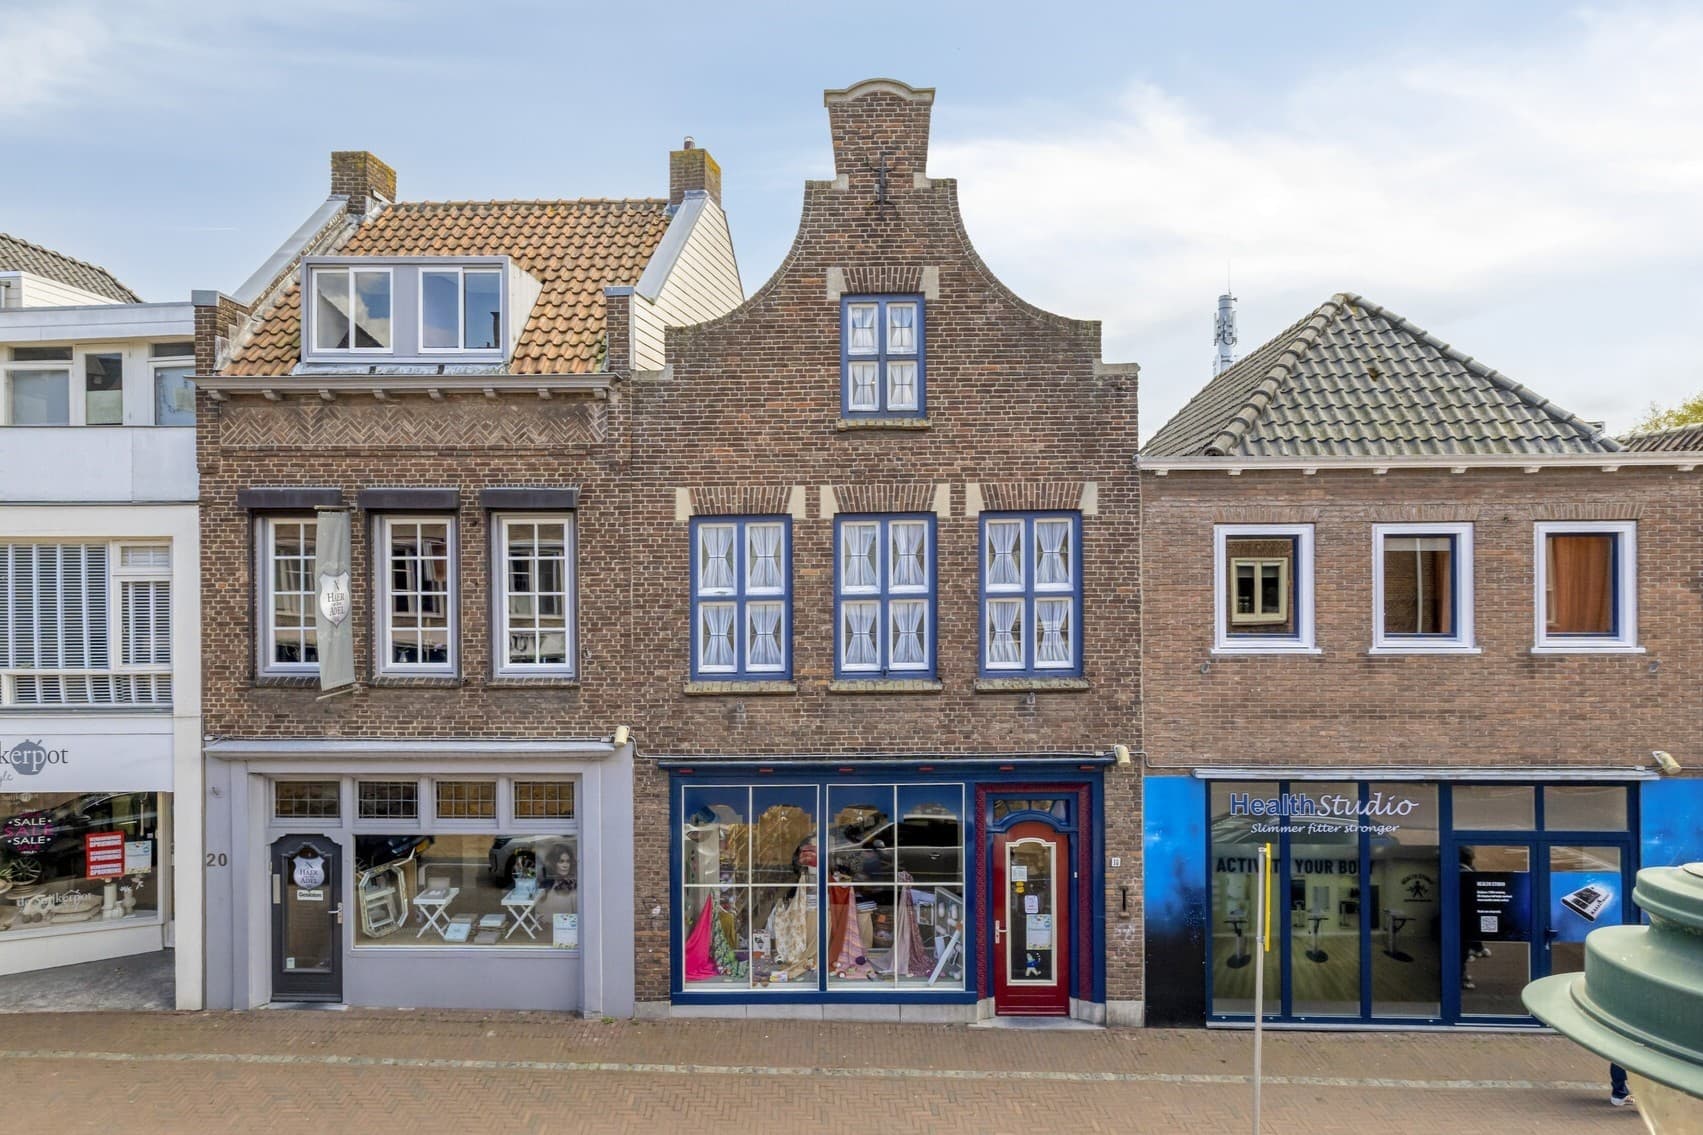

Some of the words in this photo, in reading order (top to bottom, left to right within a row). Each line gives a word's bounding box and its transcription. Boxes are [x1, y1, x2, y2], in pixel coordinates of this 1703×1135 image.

[1250, 822, 1306, 834] Slimmer
[1307, 822, 1342, 835] fitter
[1344, 823, 1400, 835] stronger
[206, 853, 228, 867] 20
[1216, 858, 1284, 873] ACTIVT
[1295, 859, 1334, 874] YOUR
